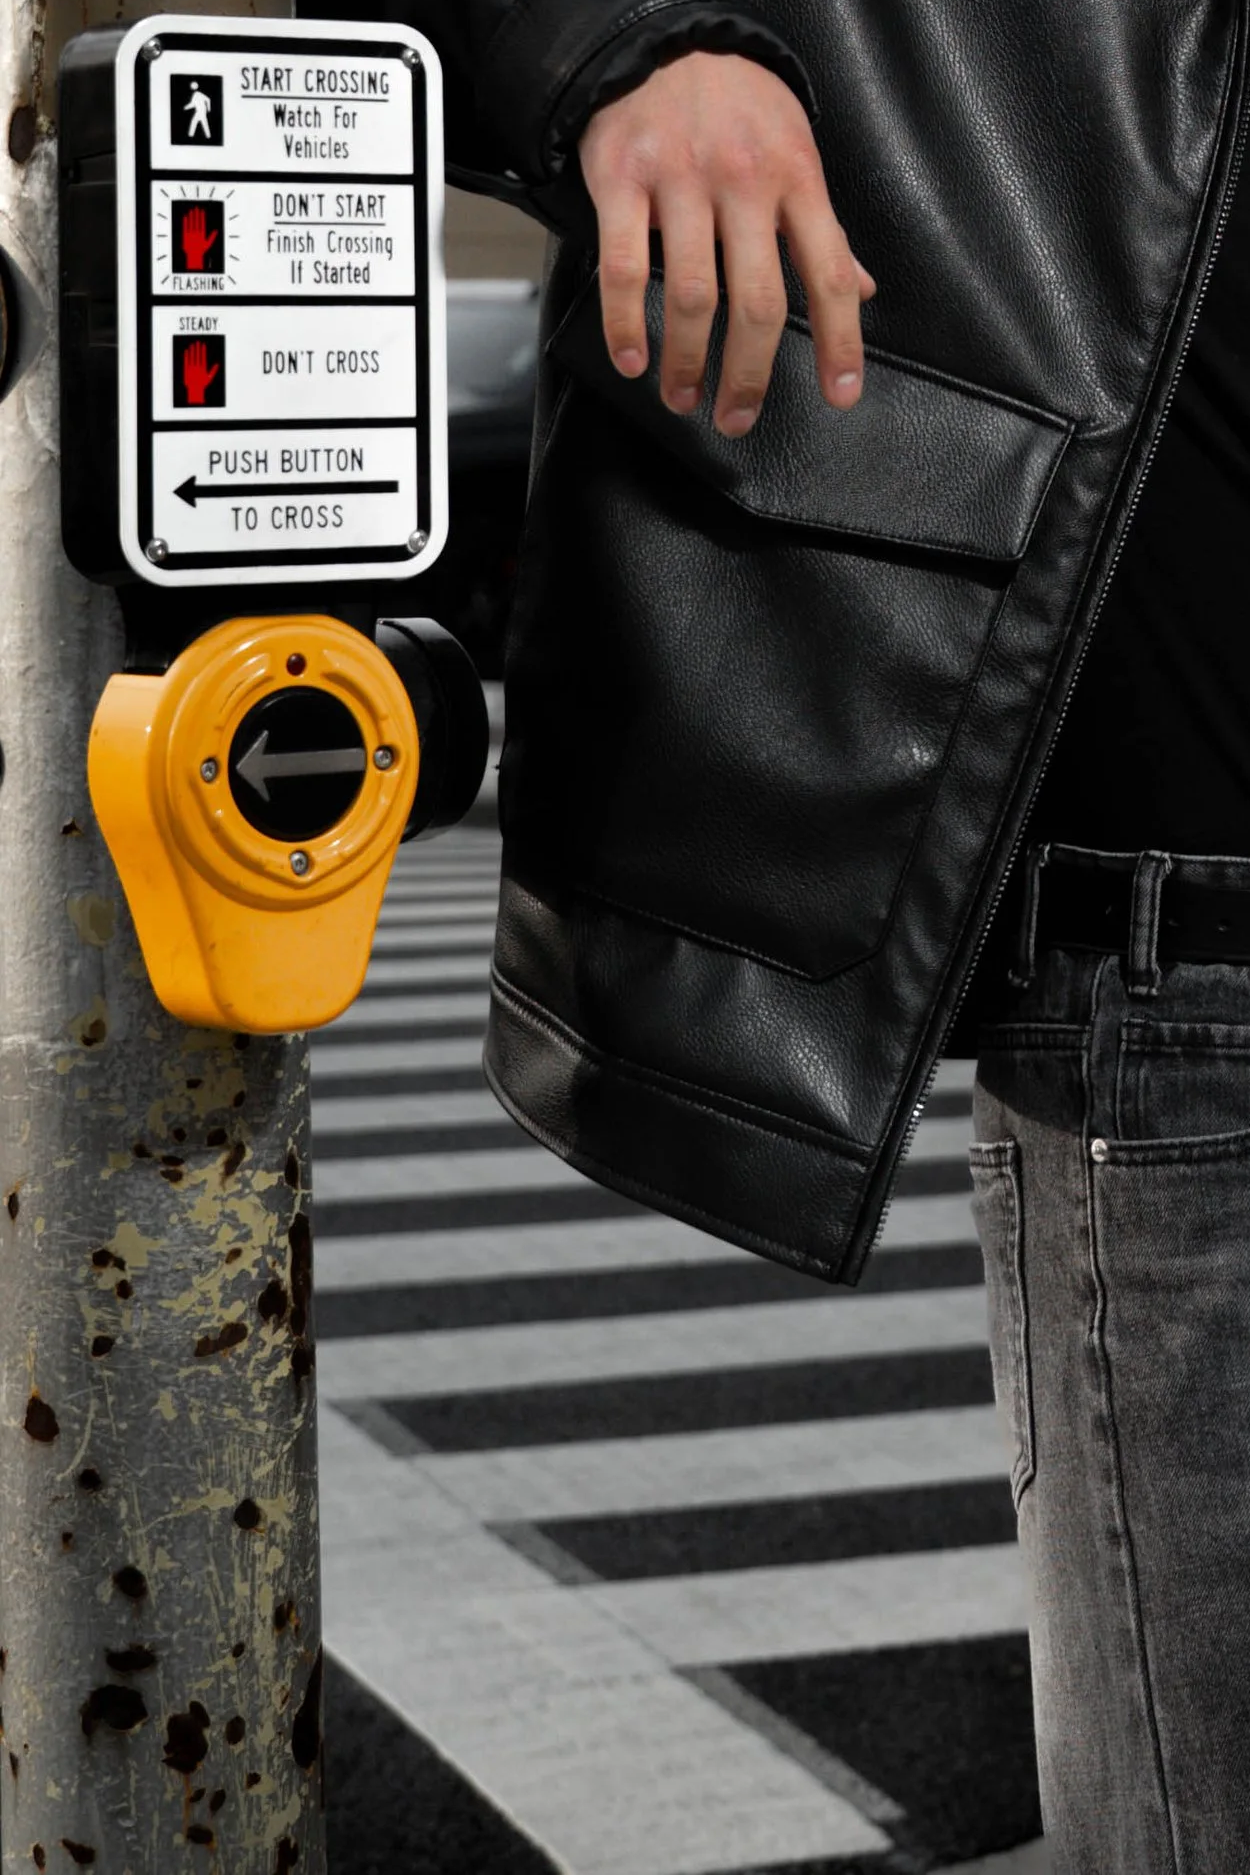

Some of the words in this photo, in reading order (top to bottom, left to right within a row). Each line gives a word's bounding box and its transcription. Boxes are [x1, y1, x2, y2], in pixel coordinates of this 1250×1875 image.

[241, 67, 293, 91] START
[304, 69, 389, 95] CROSSING
[273, 103, 322, 128] Watch
[334, 105, 358, 129] For
[284, 134, 349, 159] Vehicles
[273, 193, 324, 217] DON'T
[336, 194, 386, 218] START
[267, 229, 314, 253] Finish
[327, 231, 393, 260] Crossing
[173, 276, 225, 291] FLASHING
[291, 260, 303, 284] If
[313, 261, 370, 284] Started
[179, 316, 219, 331] STEADY
[262, 350, 314, 374] DON'T
[326, 350, 380, 373] CROSS
[209, 450, 268, 475] PUSH
[281, 448, 364, 473] BUTTON
[231, 507, 258, 531] TO
[271, 505, 343, 529] CROSS
